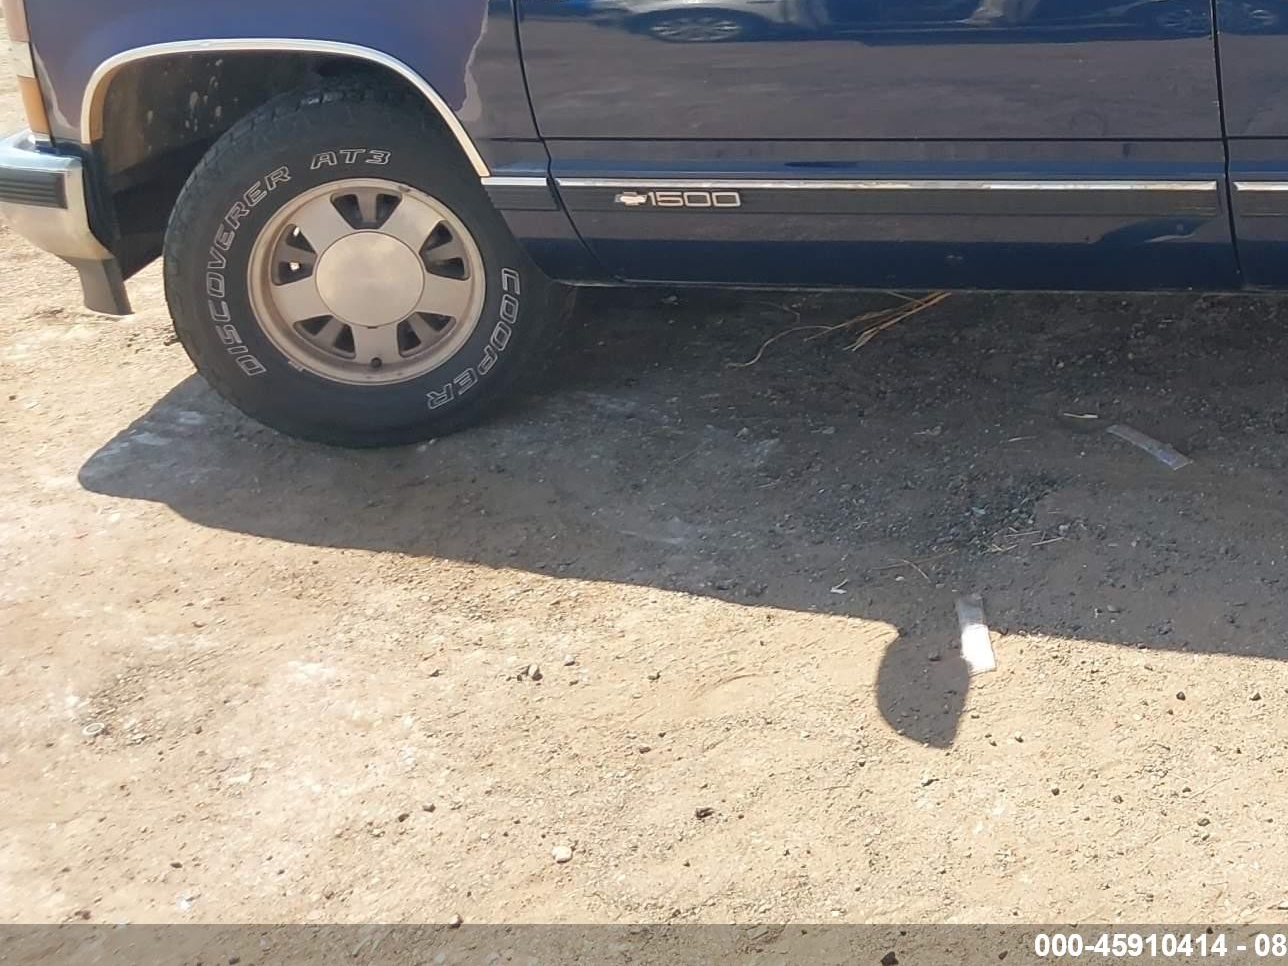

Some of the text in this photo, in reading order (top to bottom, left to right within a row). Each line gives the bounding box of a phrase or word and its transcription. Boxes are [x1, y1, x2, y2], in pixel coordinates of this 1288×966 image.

[206, 148, 392, 377] DISCOVERER AT3
[648, 191, 742, 207] 1500
[426, 267, 521, 410] COOPER
